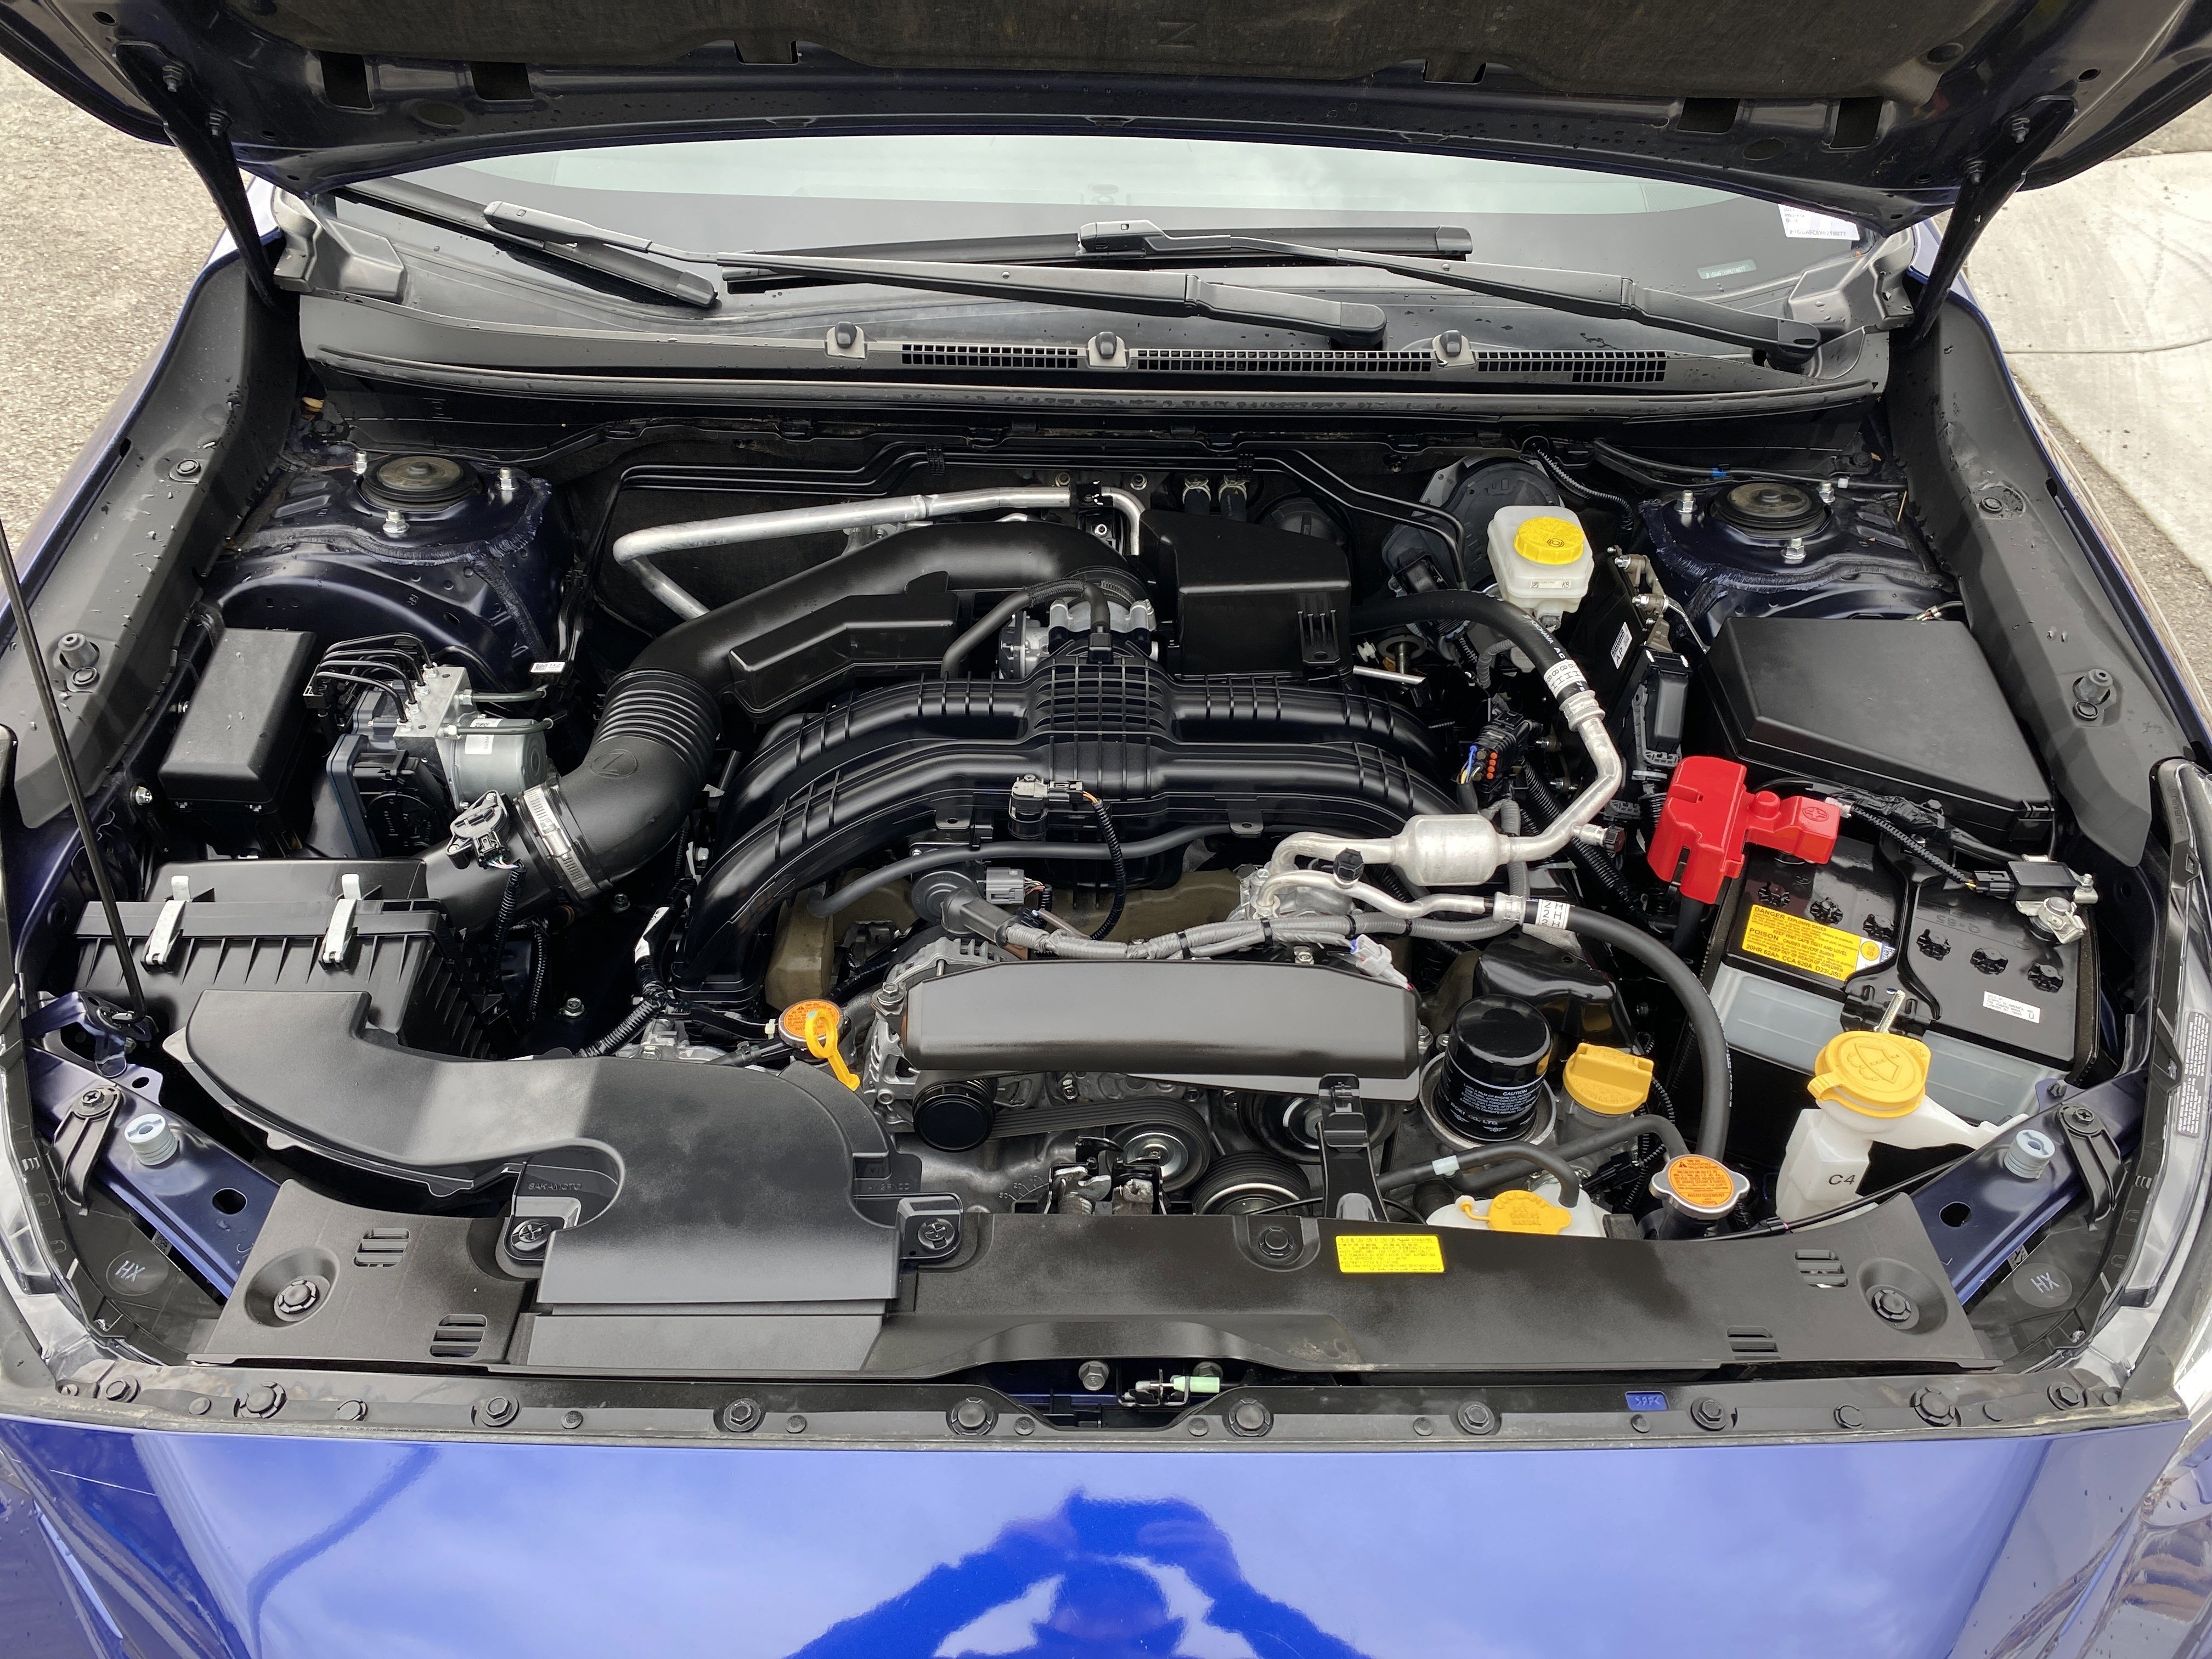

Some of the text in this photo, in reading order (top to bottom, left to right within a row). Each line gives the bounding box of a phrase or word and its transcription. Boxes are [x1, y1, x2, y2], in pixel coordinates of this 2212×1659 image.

[1543, 909, 1562, 920] 2 H
[1754, 906, 1785, 919] DANGER
[1787, 917, 1811, 927] EXPLOSIVE
[1749, 927, 1779, 941] POISON
[1782, 938, 1801, 947] CAUSES
[1746, 944, 1762, 953] 20HR
[1763, 949, 1779, 958] 62Ah
[1782, 955, 1796, 963] CCA
[1797, 960, 1813, 969] 620A
[1829, 1174, 1855, 1185] C4
[1494, 1192, 1550, 1210] COOLANT
[115, 1260, 145, 1282] HX
[2030, 1272, 2060, 1293] HX
